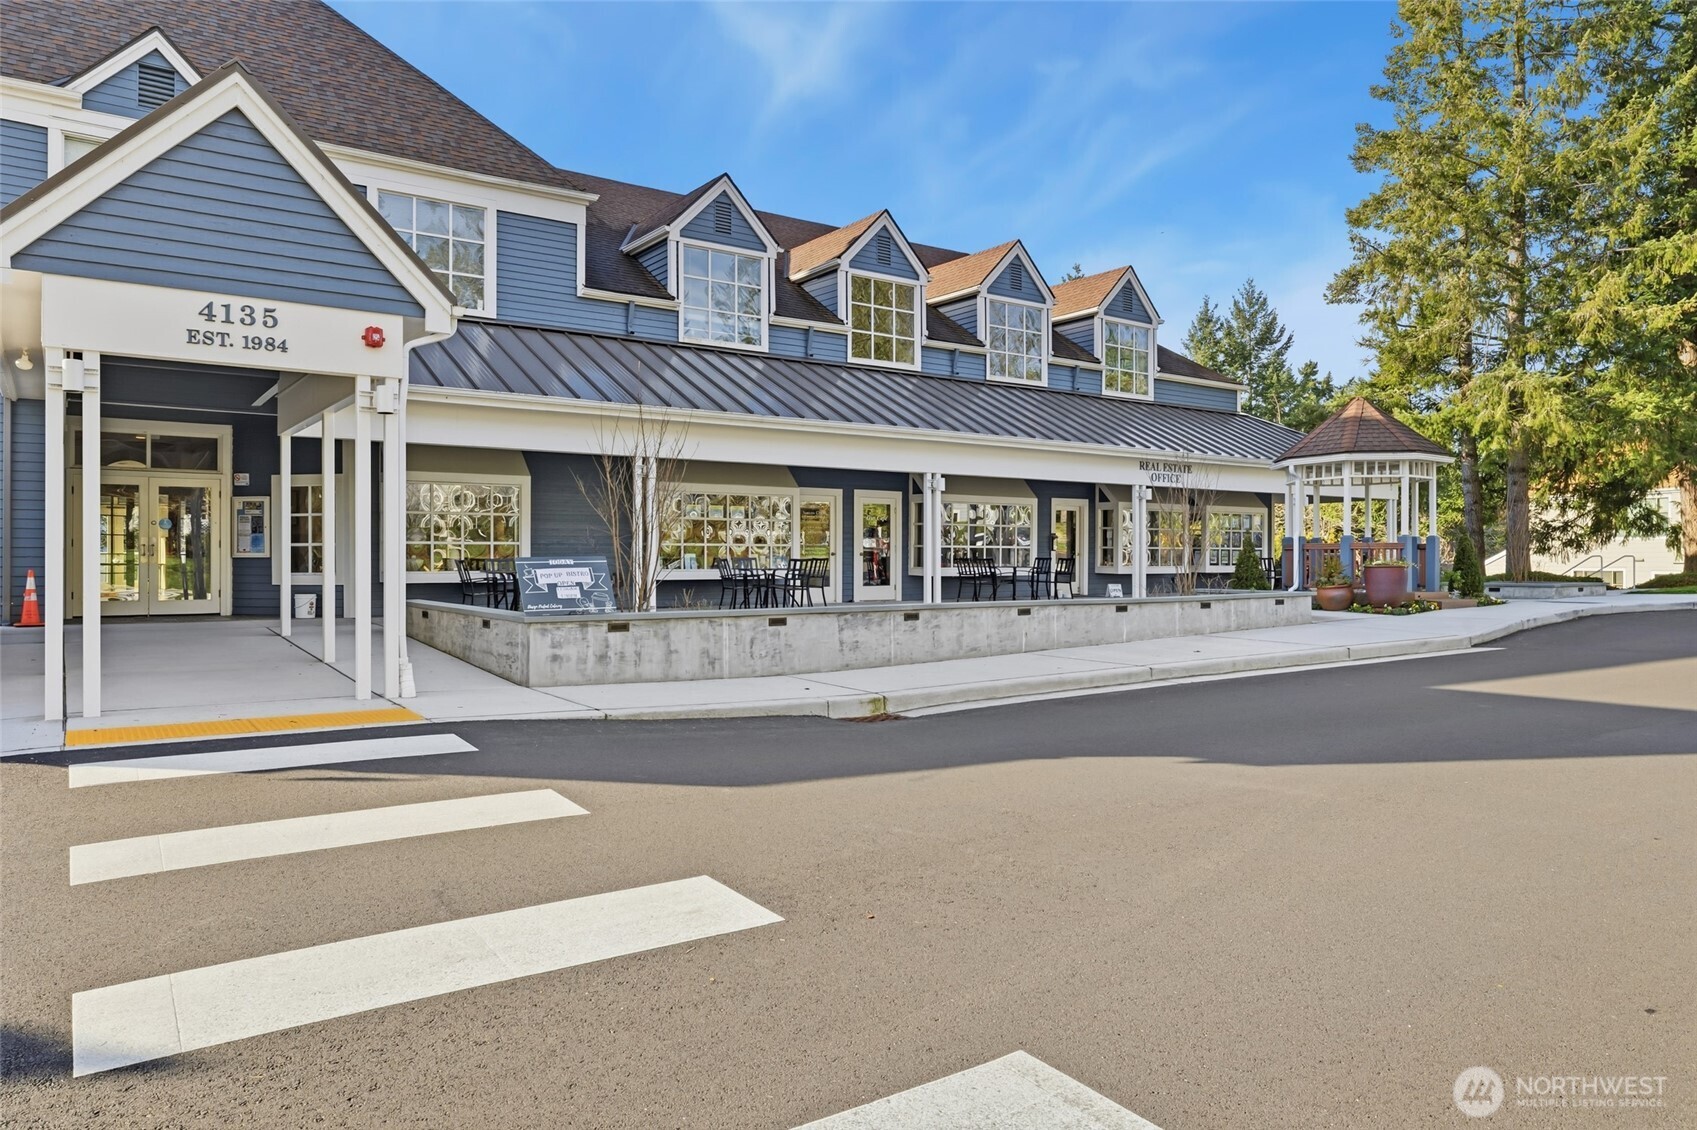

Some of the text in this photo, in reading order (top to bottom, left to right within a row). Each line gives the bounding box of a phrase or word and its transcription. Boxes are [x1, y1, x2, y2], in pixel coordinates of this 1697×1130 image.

[198, 300, 279, 329] 4135
[186, 328, 289, 353] EST. 1984
[1139, 461, 1192, 473] REAL ESTATE
[1151, 473, 1181, 483] OFFICE
